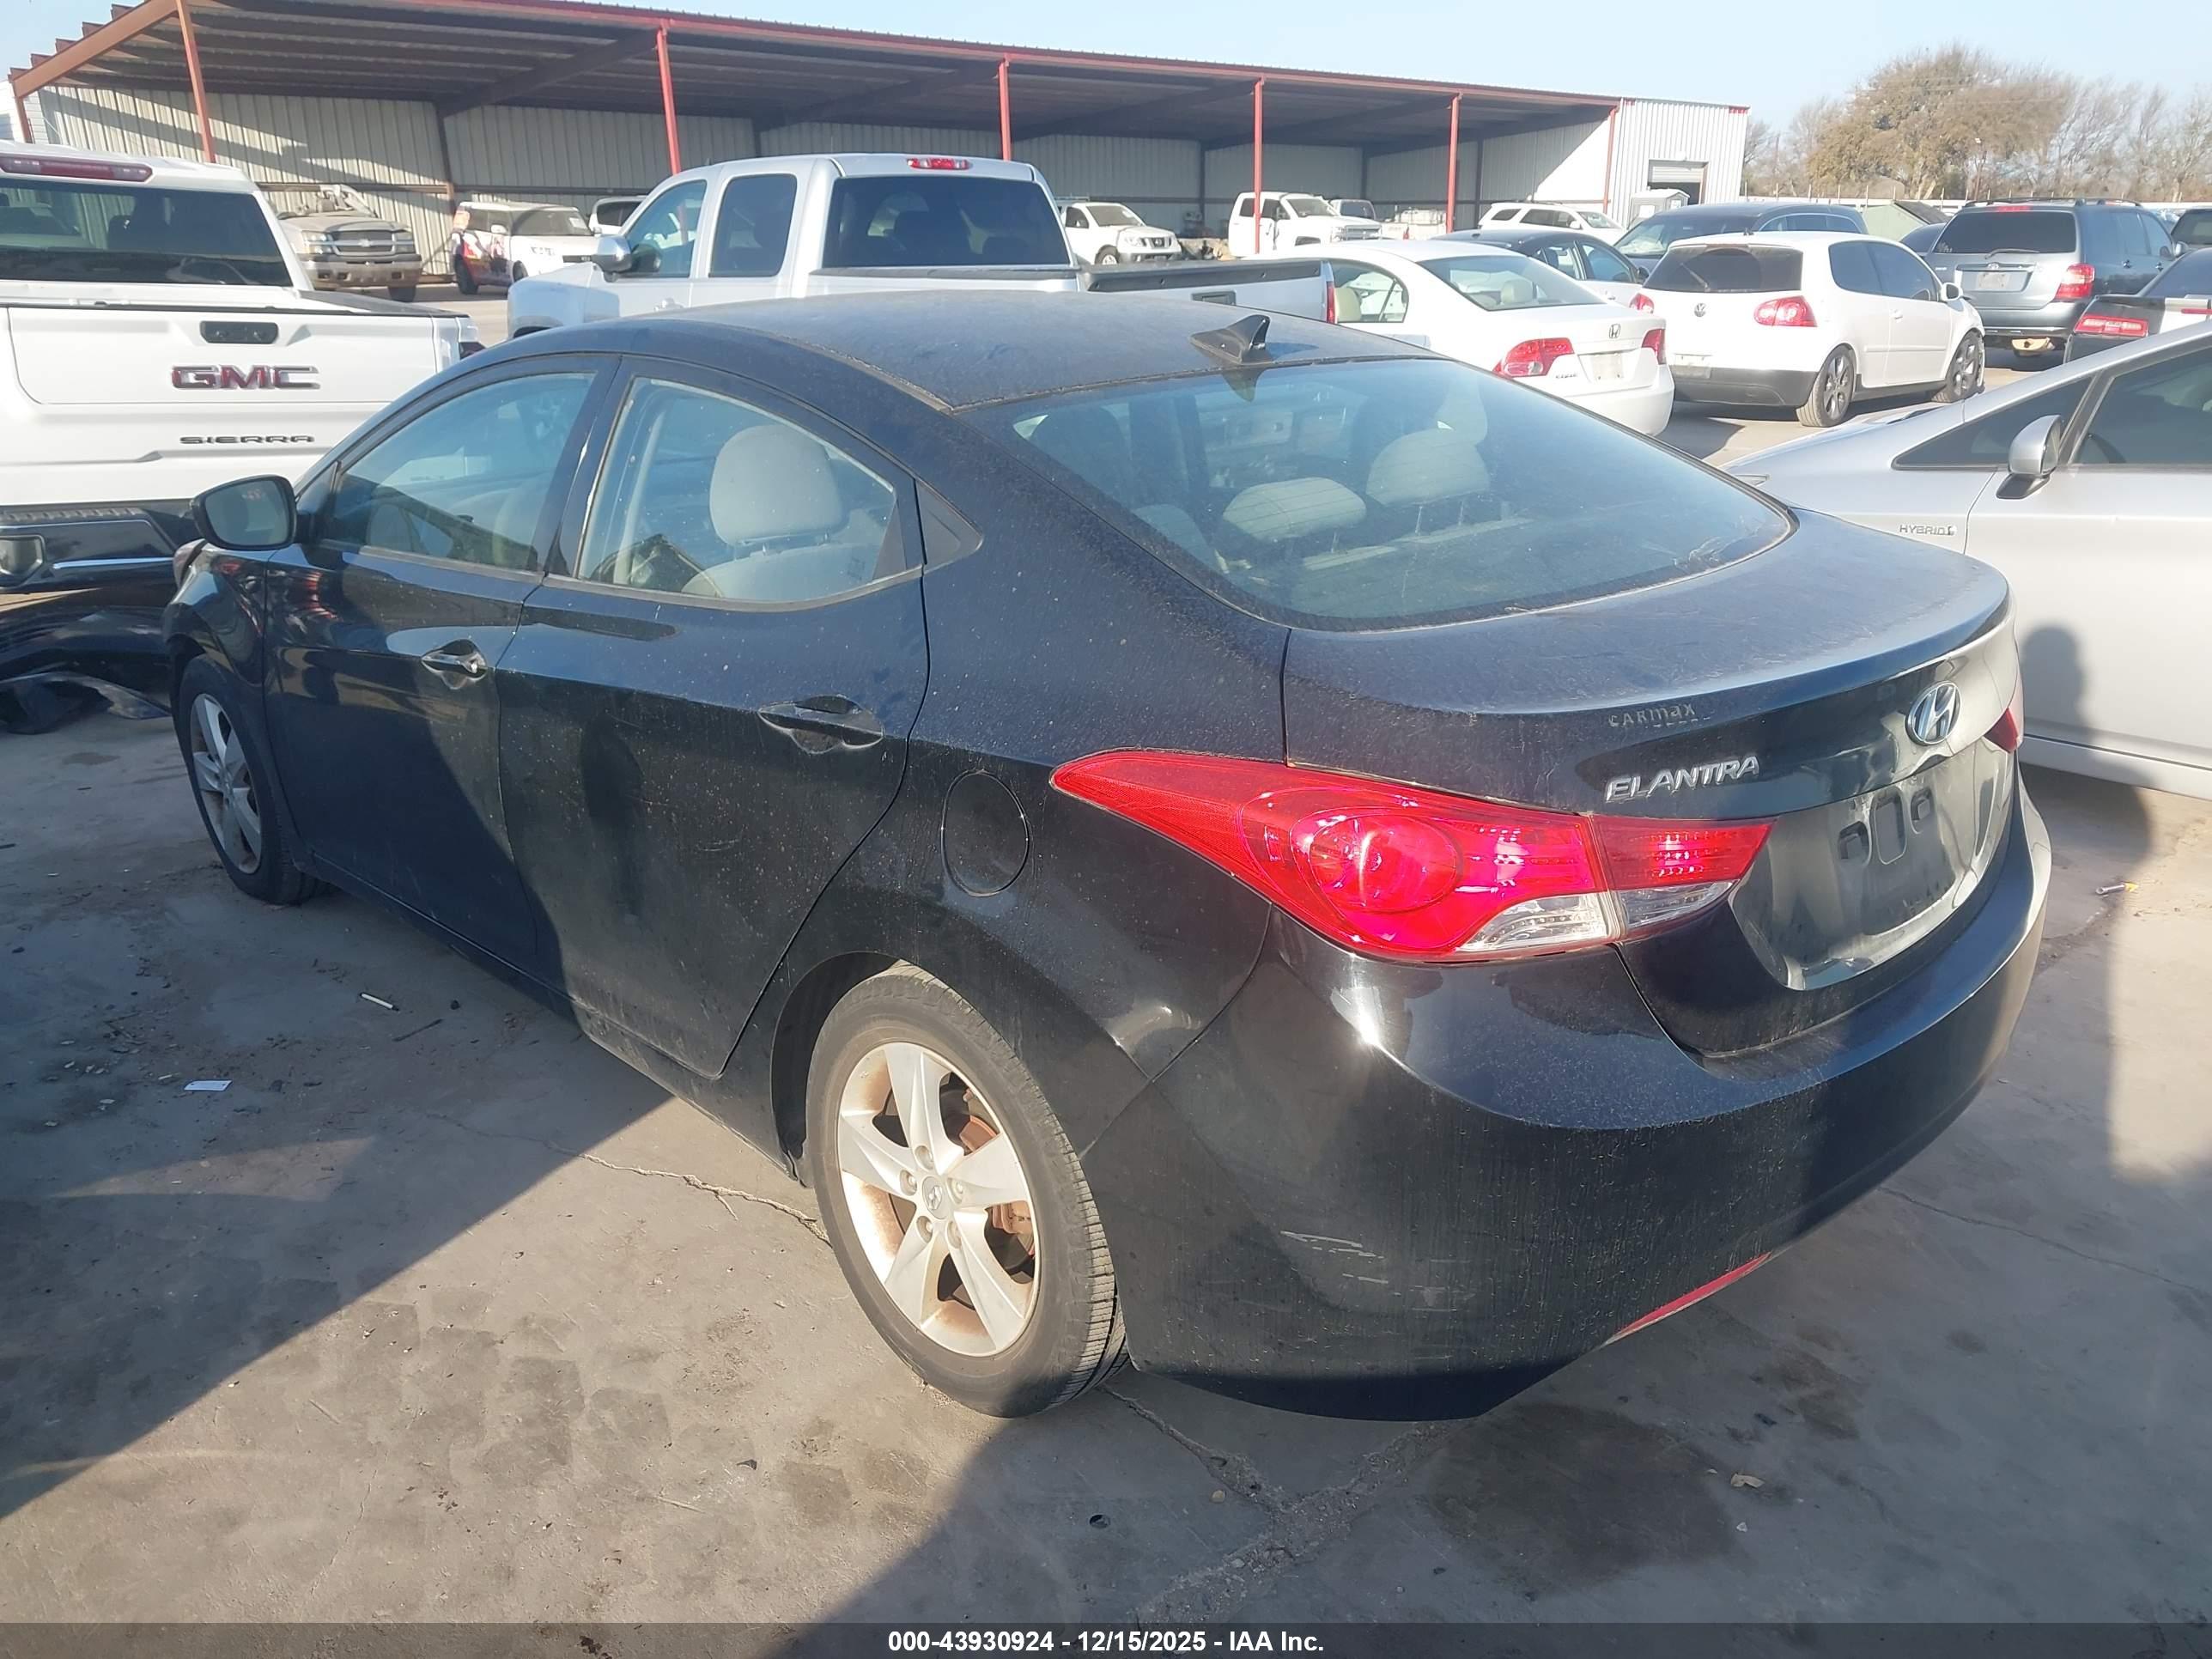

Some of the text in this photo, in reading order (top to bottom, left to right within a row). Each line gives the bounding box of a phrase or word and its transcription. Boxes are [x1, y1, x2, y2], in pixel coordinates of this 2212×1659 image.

[172, 365, 320, 390] GMC
[179, 435, 315, 444] SIERRA
[1899, 525, 1946, 536] HYBRID
[1606, 756, 1759, 803] ELANTRA
